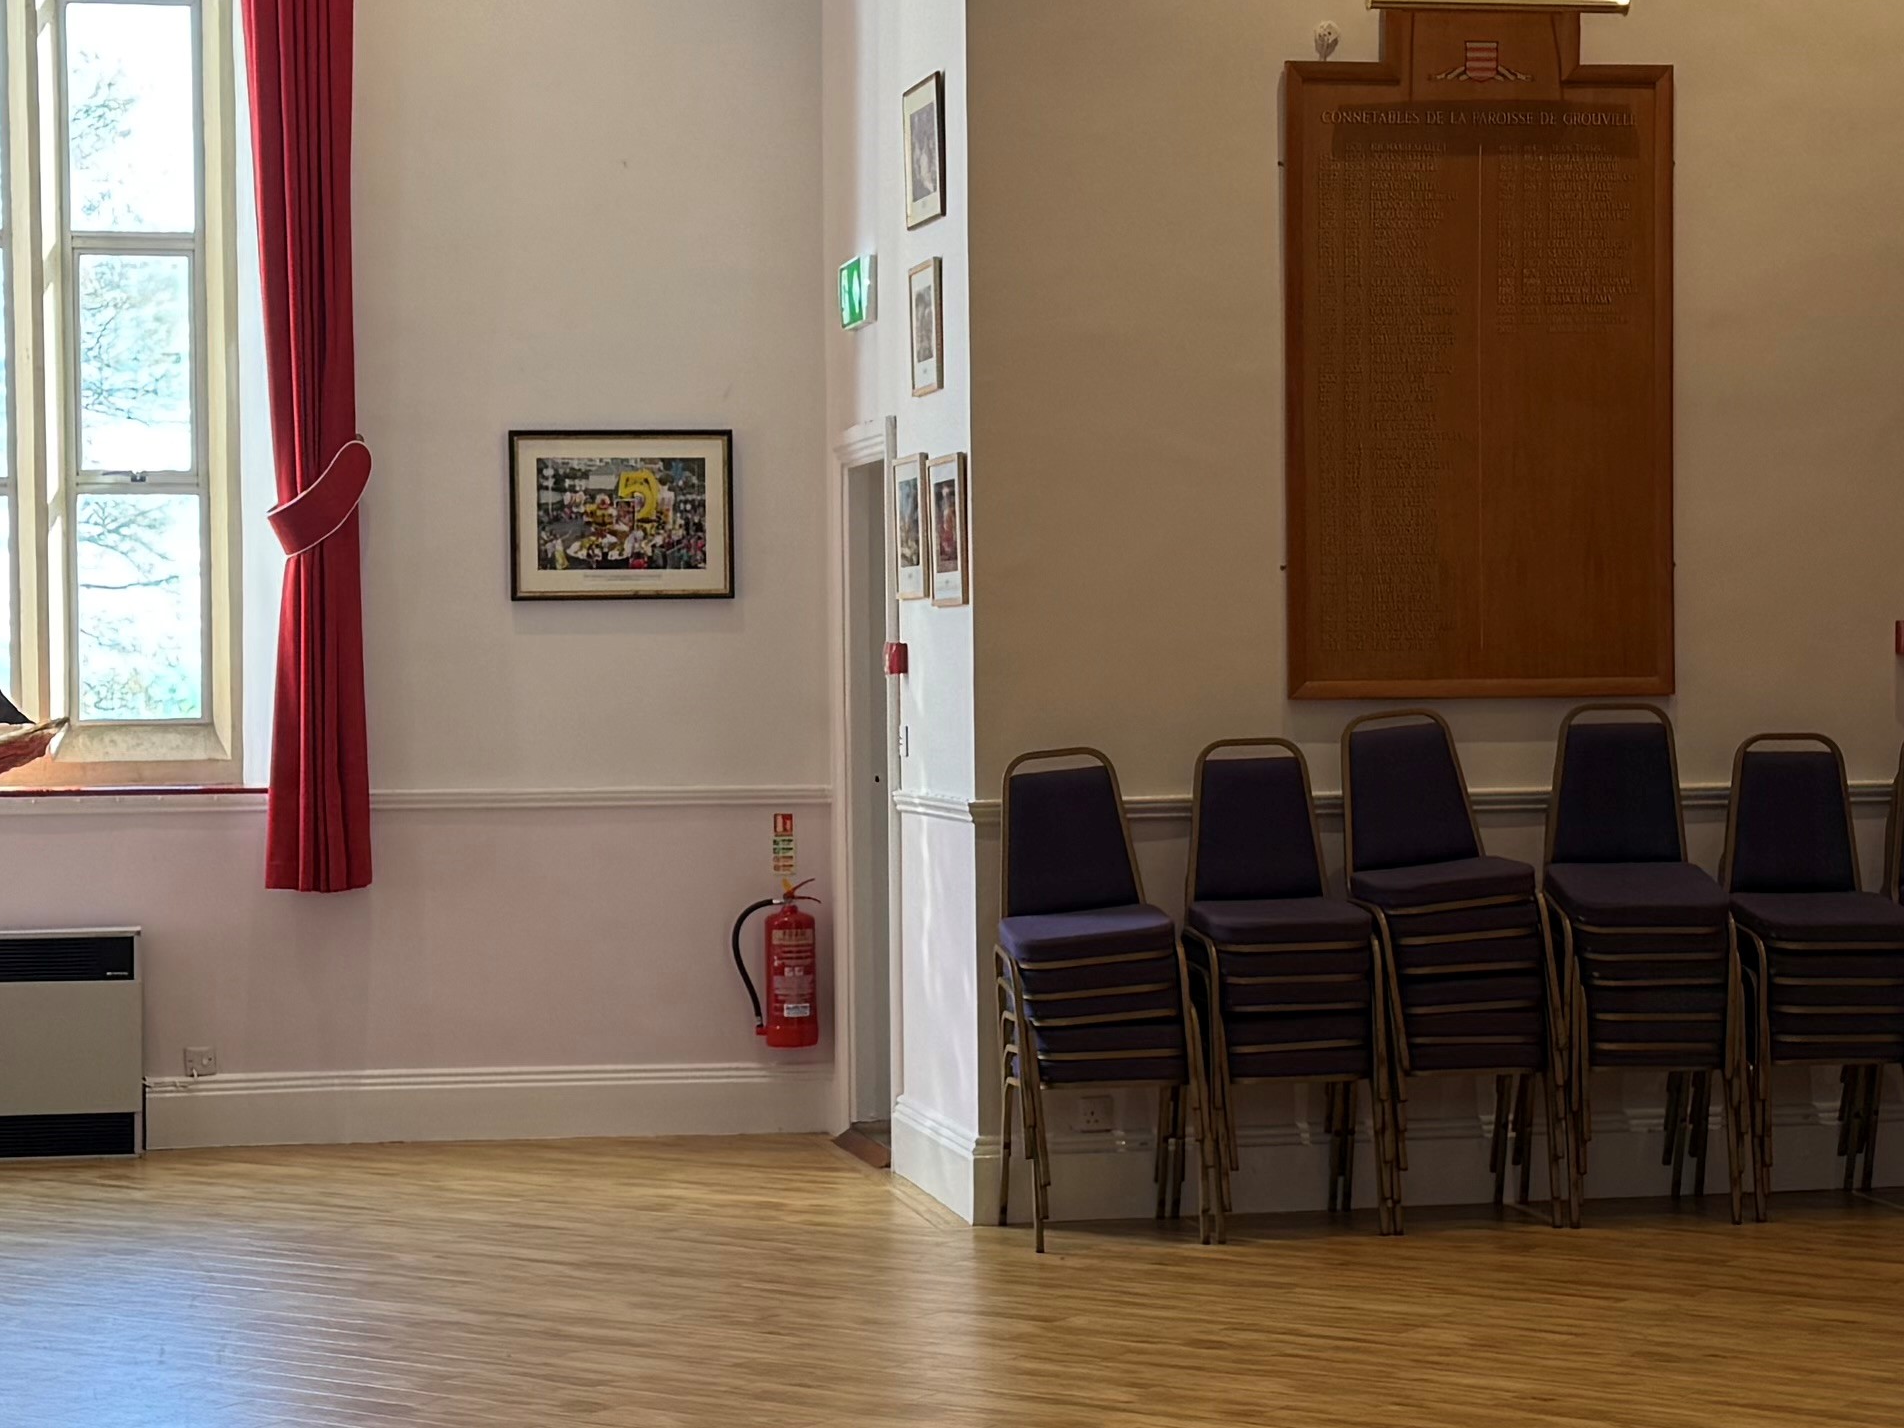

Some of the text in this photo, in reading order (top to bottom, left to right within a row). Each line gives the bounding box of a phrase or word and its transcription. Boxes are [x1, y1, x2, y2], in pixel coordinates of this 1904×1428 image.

[1426, 110, 1444, 125] DE
[1450, 111, 1467, 125] LA
[1472, 111, 1534, 125] PAROISSE
[1539, 112, 1557, 126] DE
[1562, 112, 1638, 127] GROUVILLE
